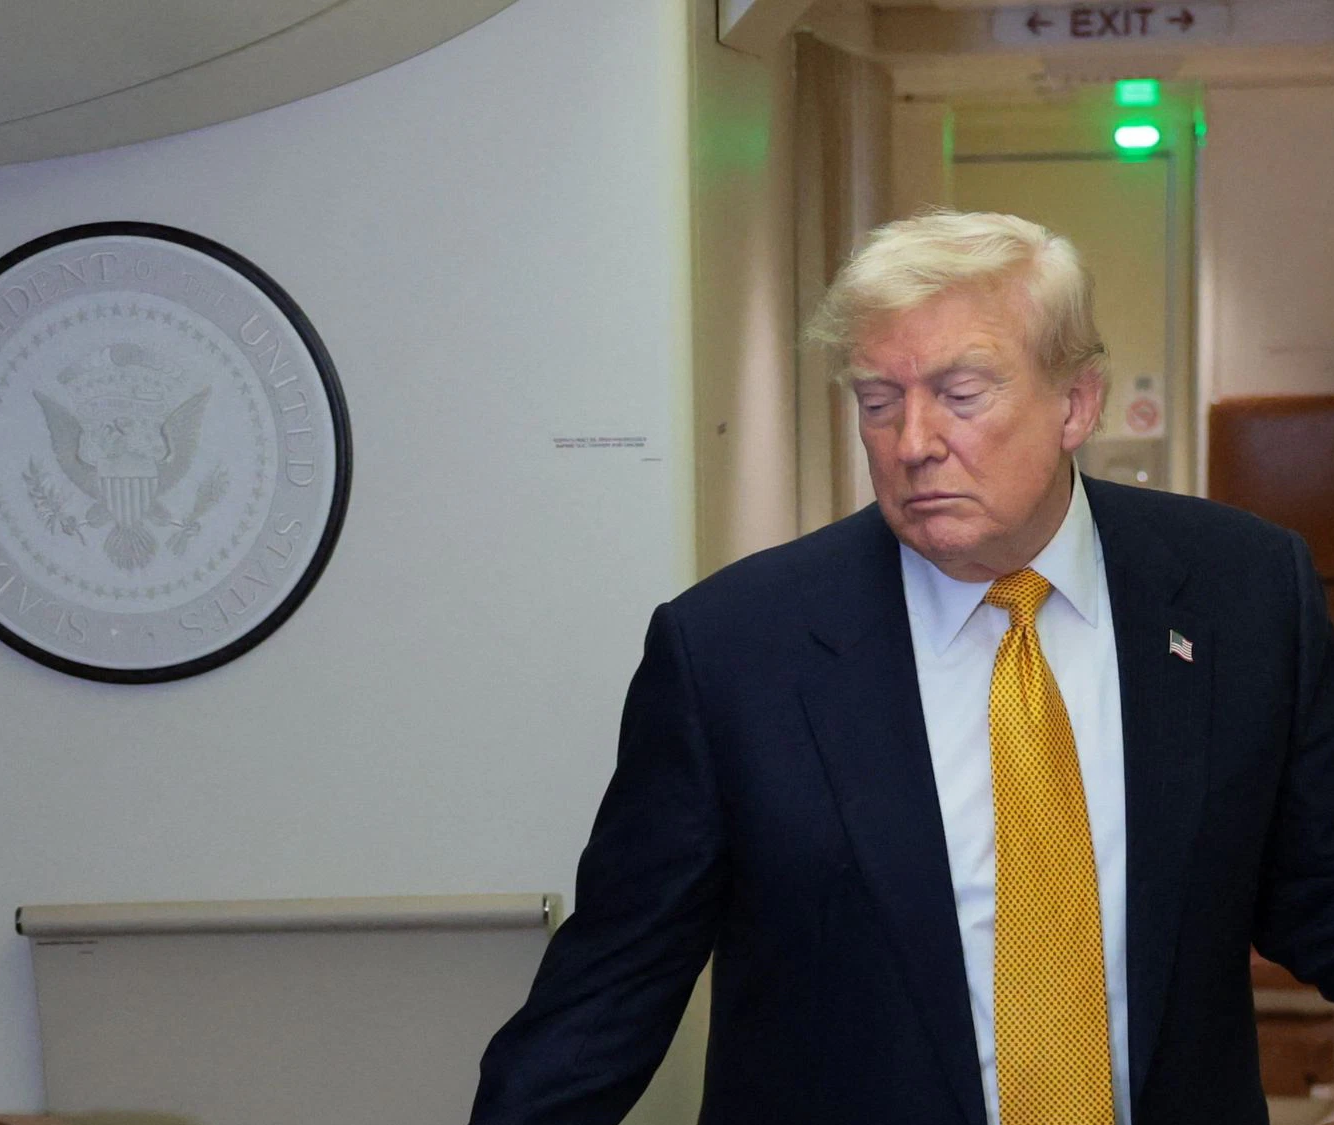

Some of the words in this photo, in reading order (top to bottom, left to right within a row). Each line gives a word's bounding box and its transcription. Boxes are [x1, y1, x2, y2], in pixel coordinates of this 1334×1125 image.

[1070, 8, 1155, 37] EXIT
[238, 311, 316, 488] UNITED
[178, 511, 303, 639] STATES
